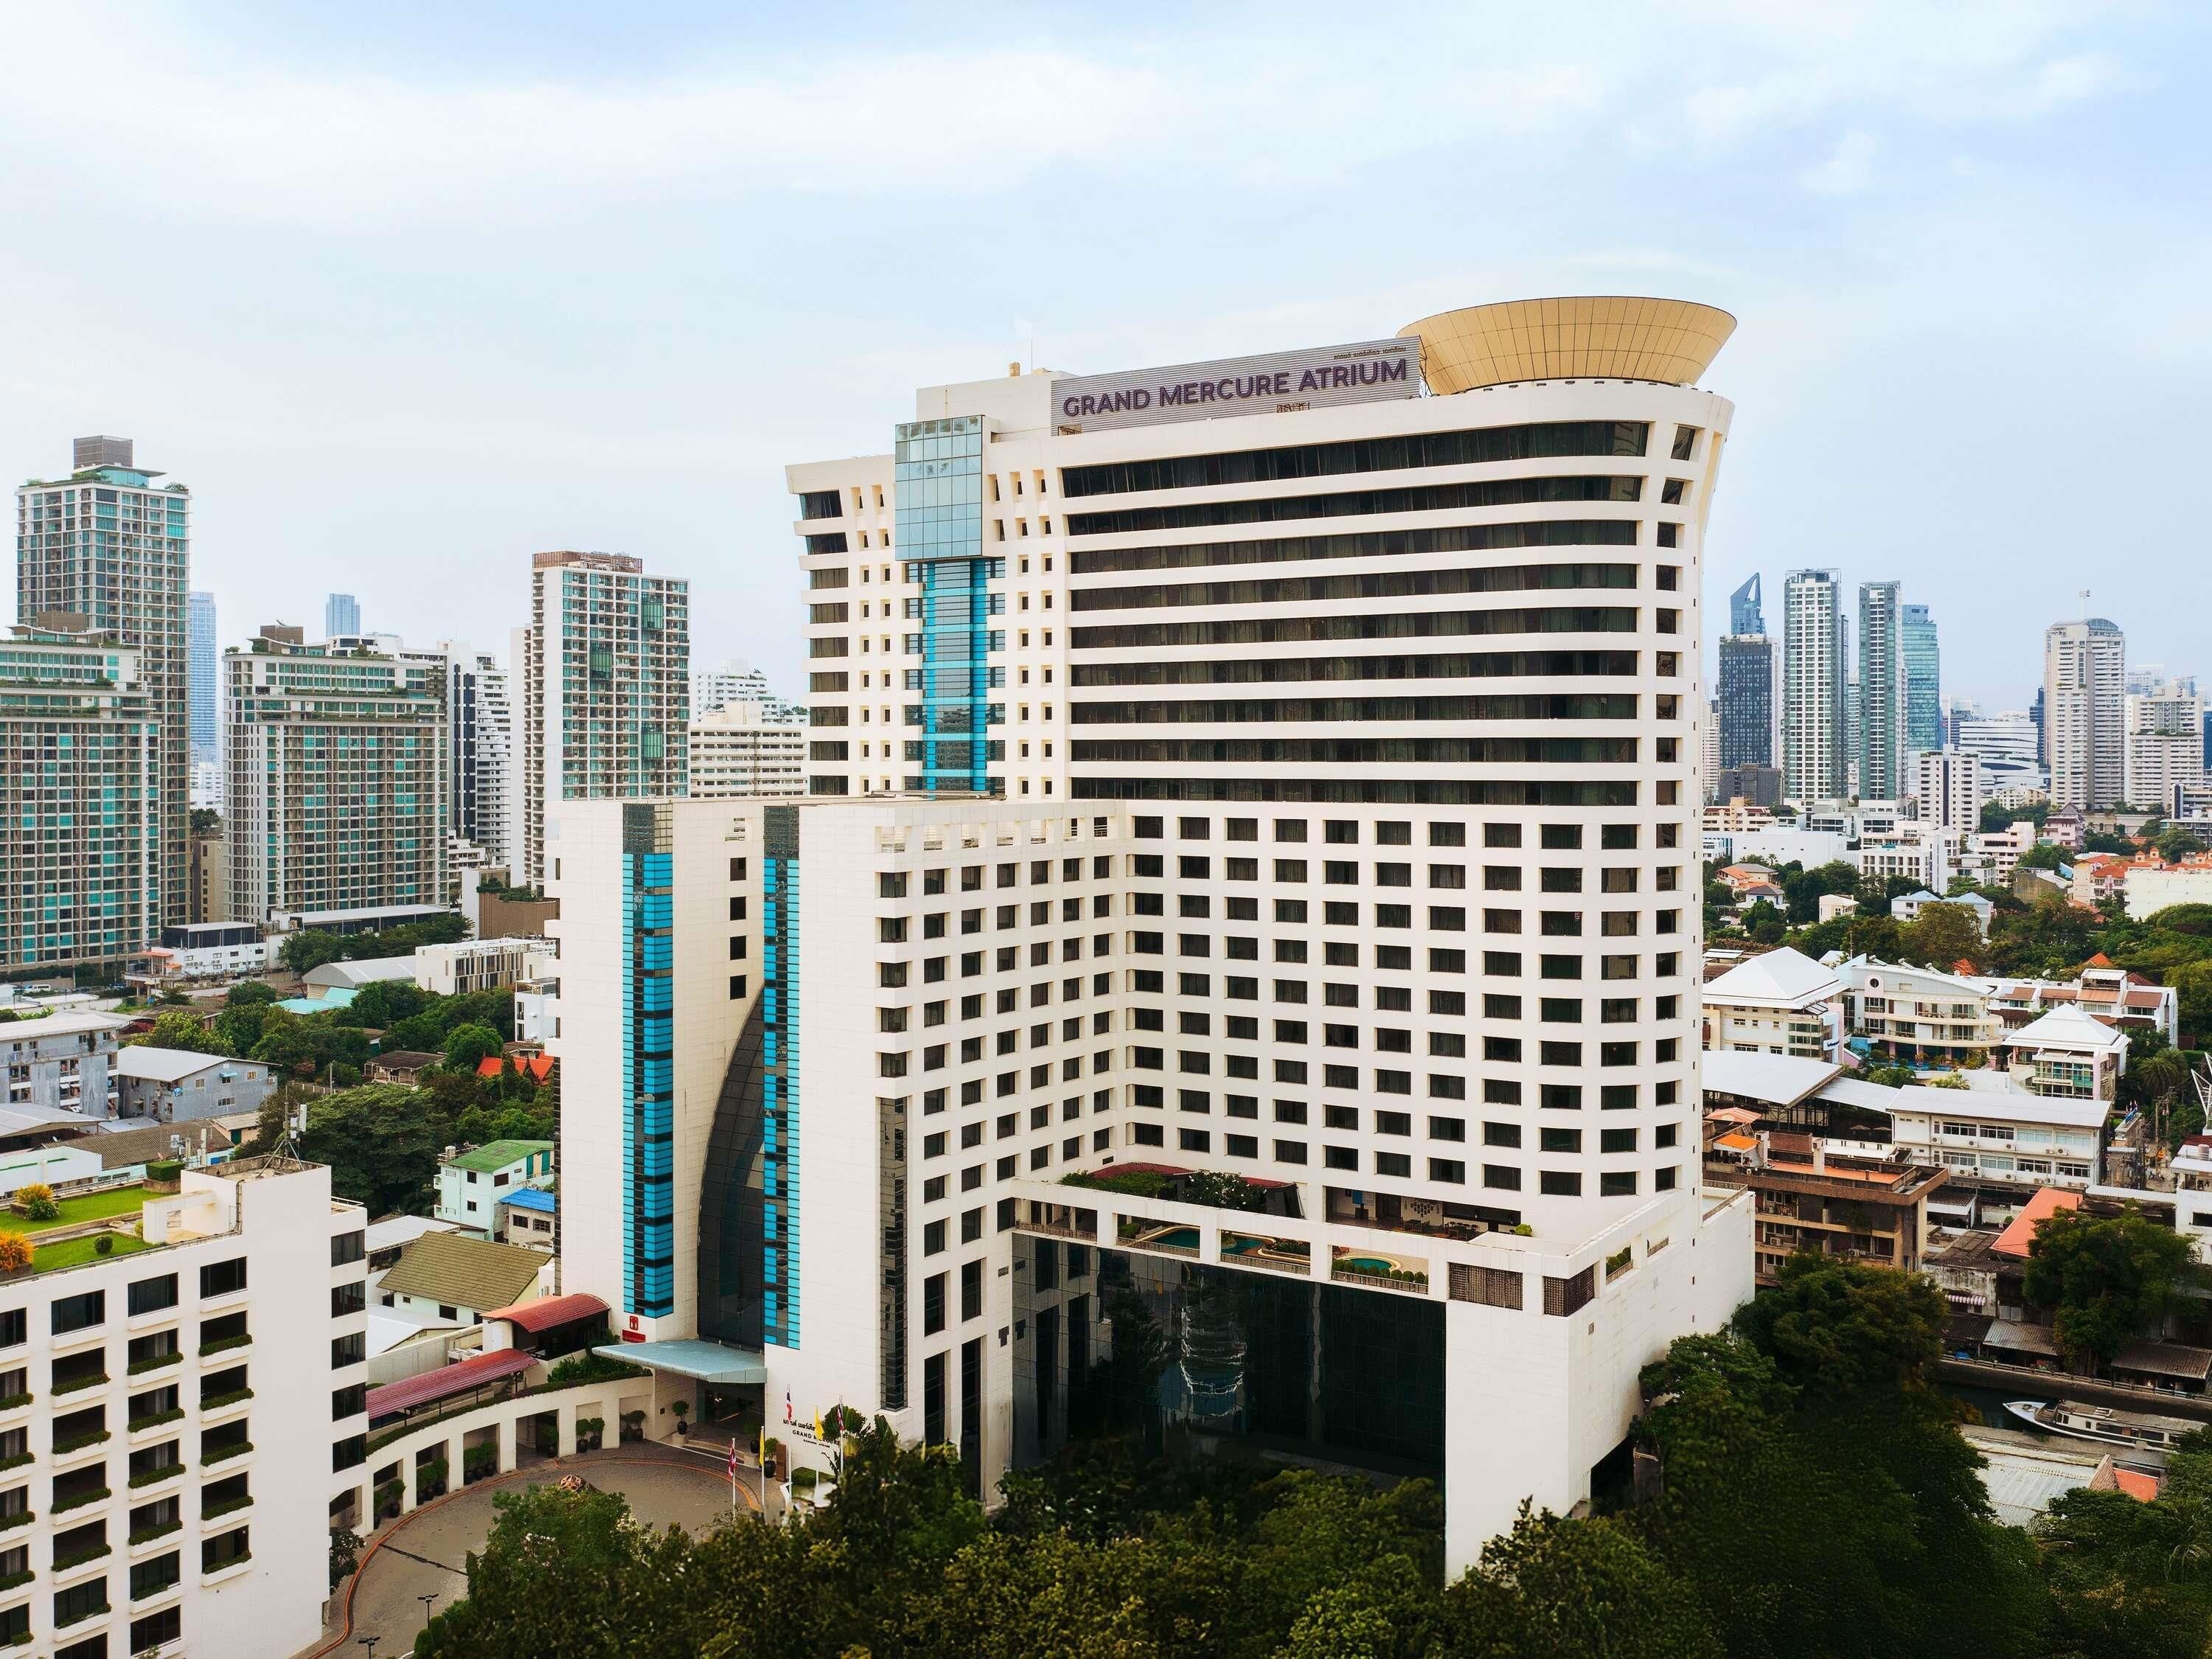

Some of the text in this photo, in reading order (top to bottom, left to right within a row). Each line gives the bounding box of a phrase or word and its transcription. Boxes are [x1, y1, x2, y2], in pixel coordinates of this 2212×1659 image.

[1062, 358, 1405, 417] GRAND MERCURE ATRIUM
[793, 1430, 812, 1439] GRAND
